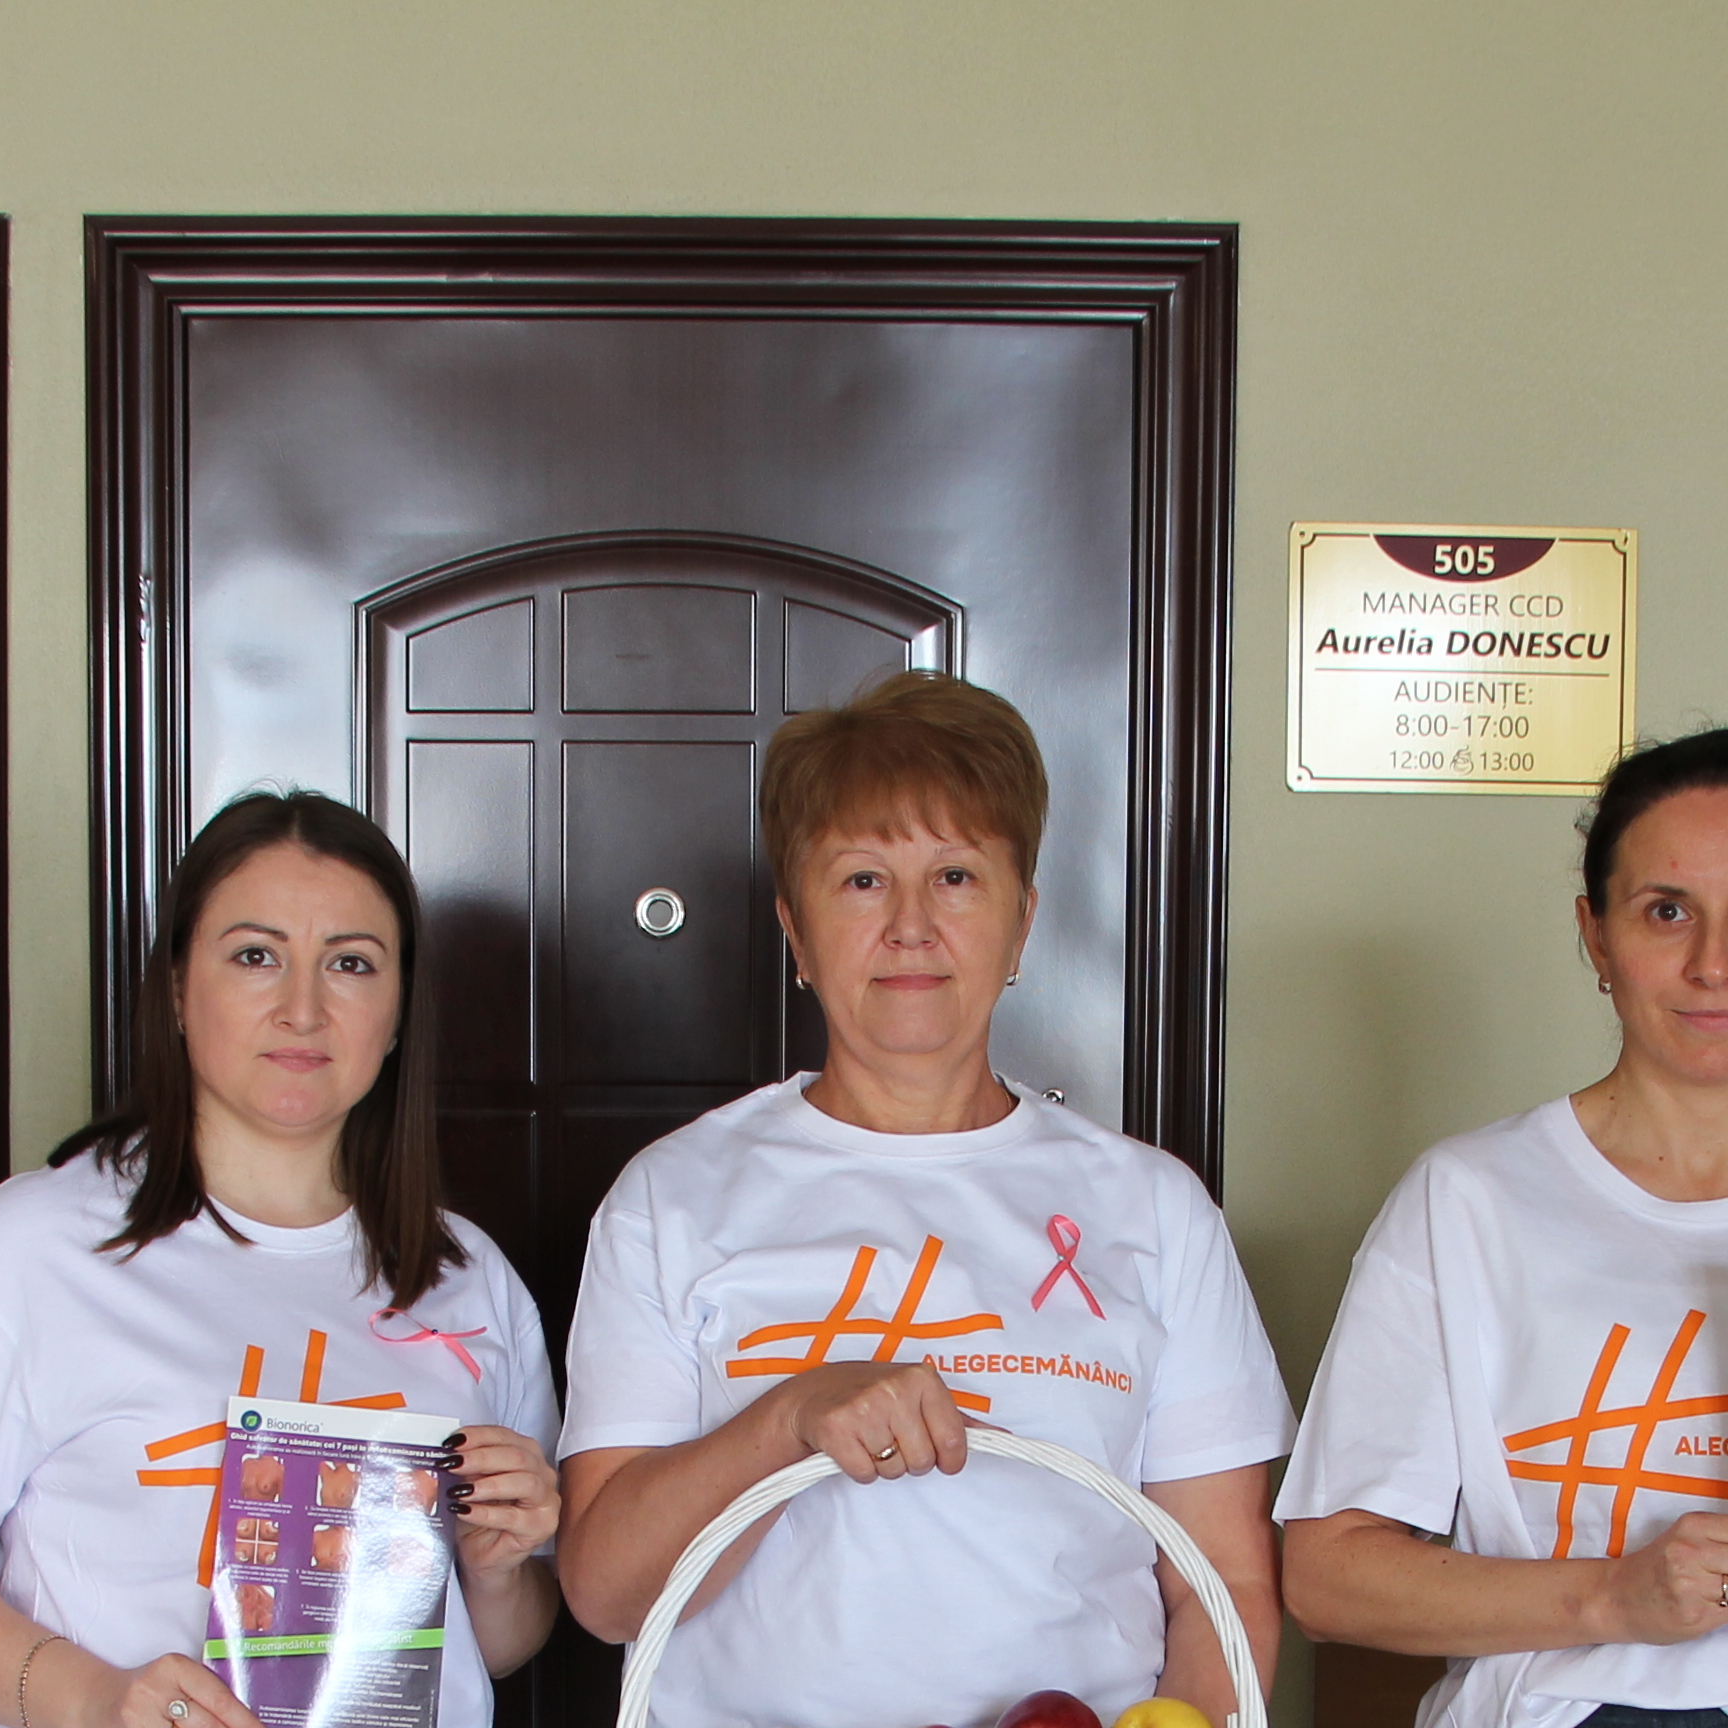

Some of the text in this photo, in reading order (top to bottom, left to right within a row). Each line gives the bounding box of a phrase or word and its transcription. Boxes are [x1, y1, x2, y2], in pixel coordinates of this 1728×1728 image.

[1433, 544, 1495, 575] 505
[1362, 592, 1564, 618] MANAGER CCD
[1315, 628, 1610, 660] Aurelia DONESCU
[1394, 680, 1534, 710] AUDIENȚE:
[1395, 714, 1530, 739] 8:00-17:00
[1389, 751, 1535, 772] 12:00 13:00
